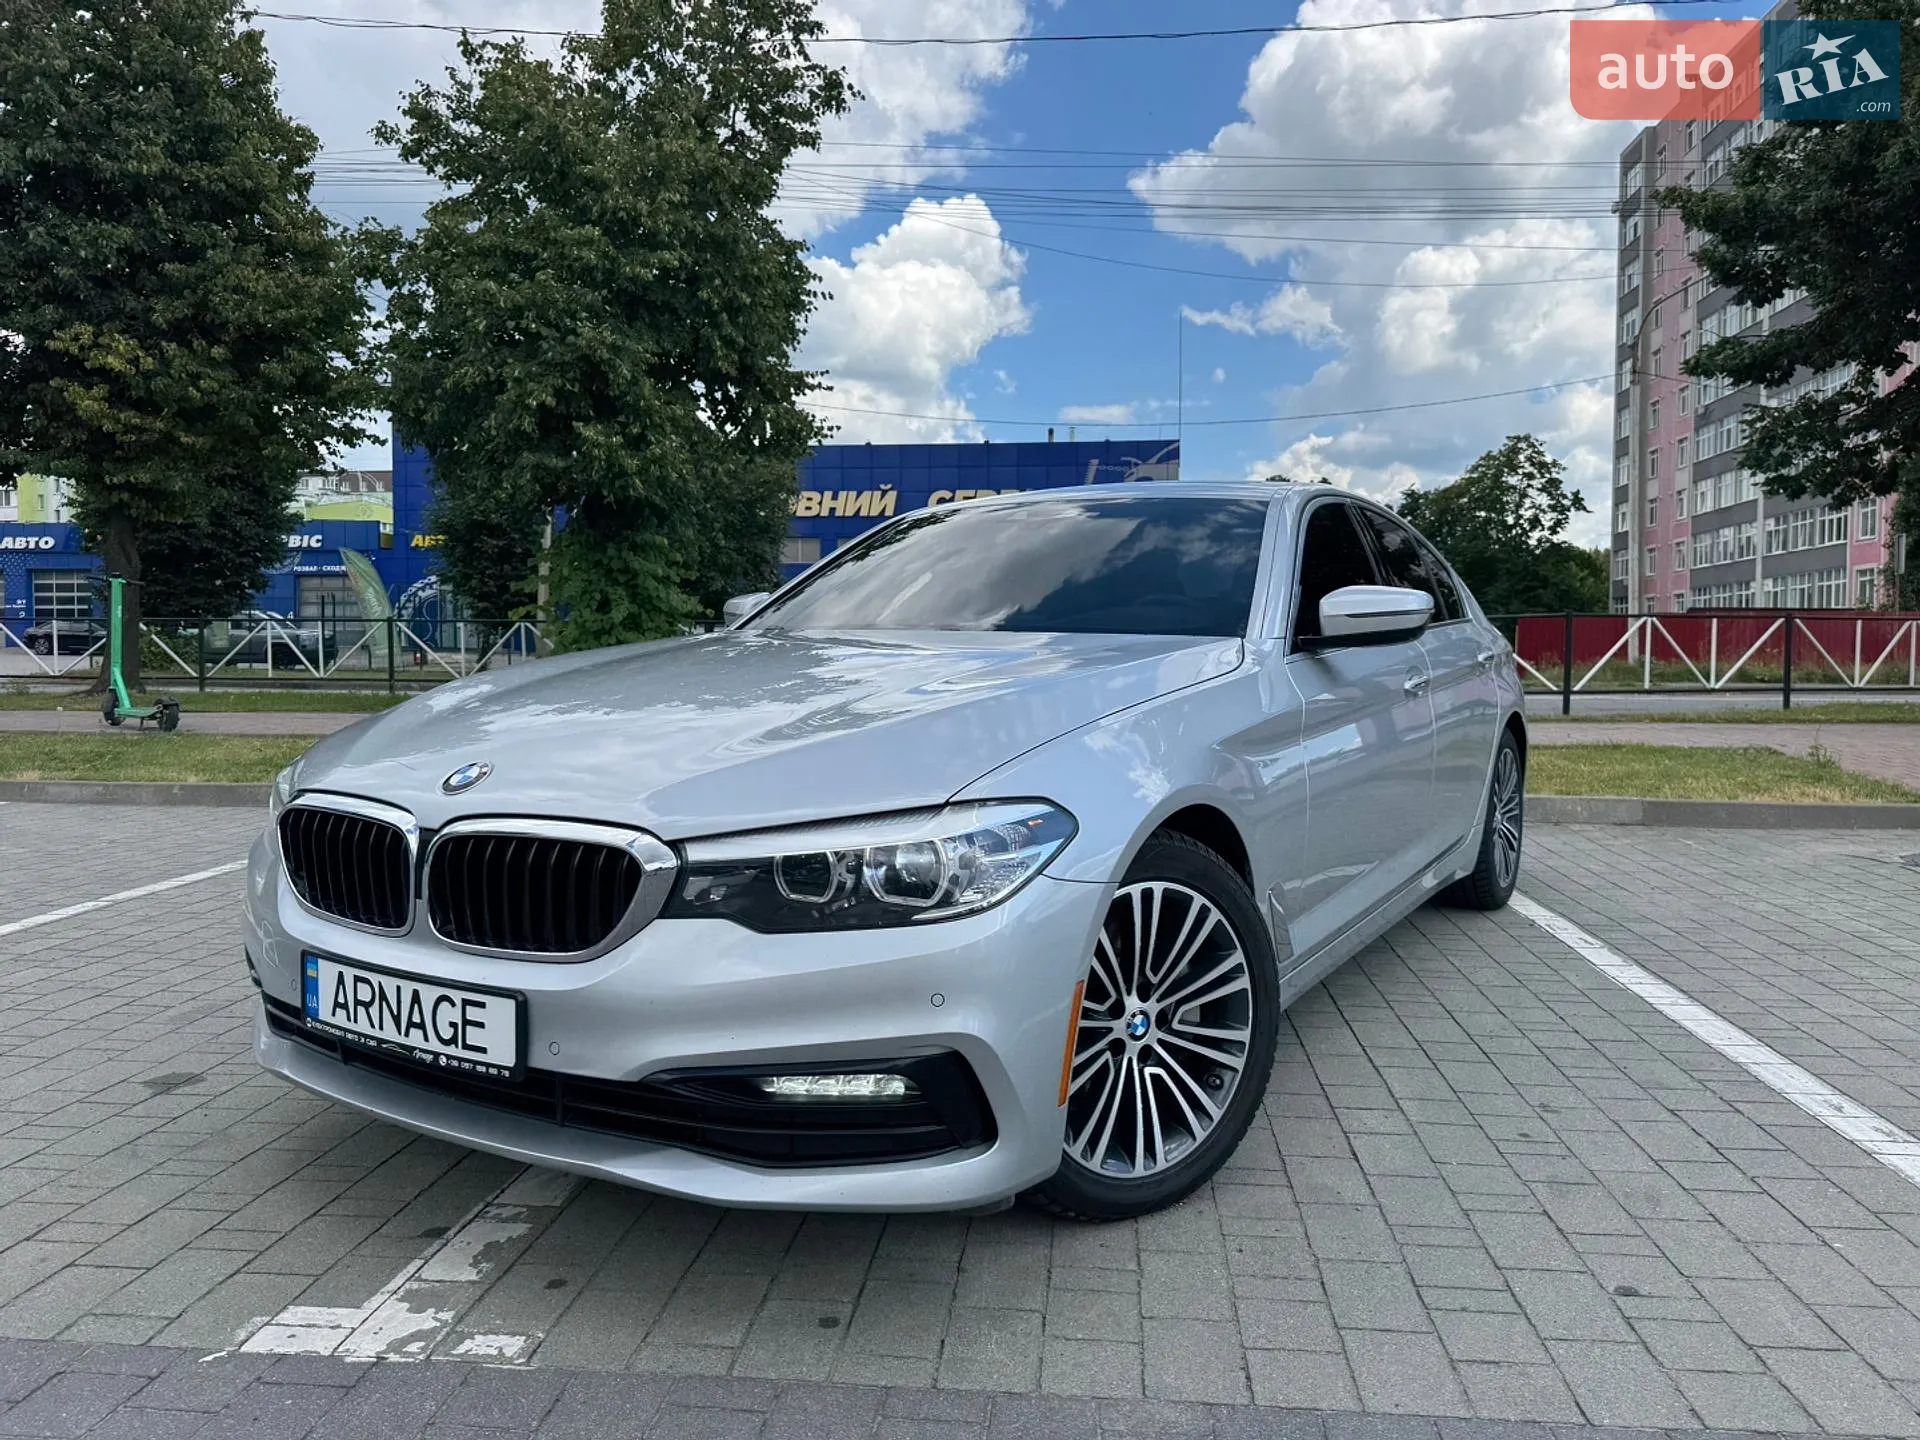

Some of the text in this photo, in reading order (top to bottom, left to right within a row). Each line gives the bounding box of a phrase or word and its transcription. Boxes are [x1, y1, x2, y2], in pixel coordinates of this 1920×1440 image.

[0, 536, 56, 549] АВТО
[306, 993, 318, 1008] UA
[331, 970, 488, 1055] ARNAGE
